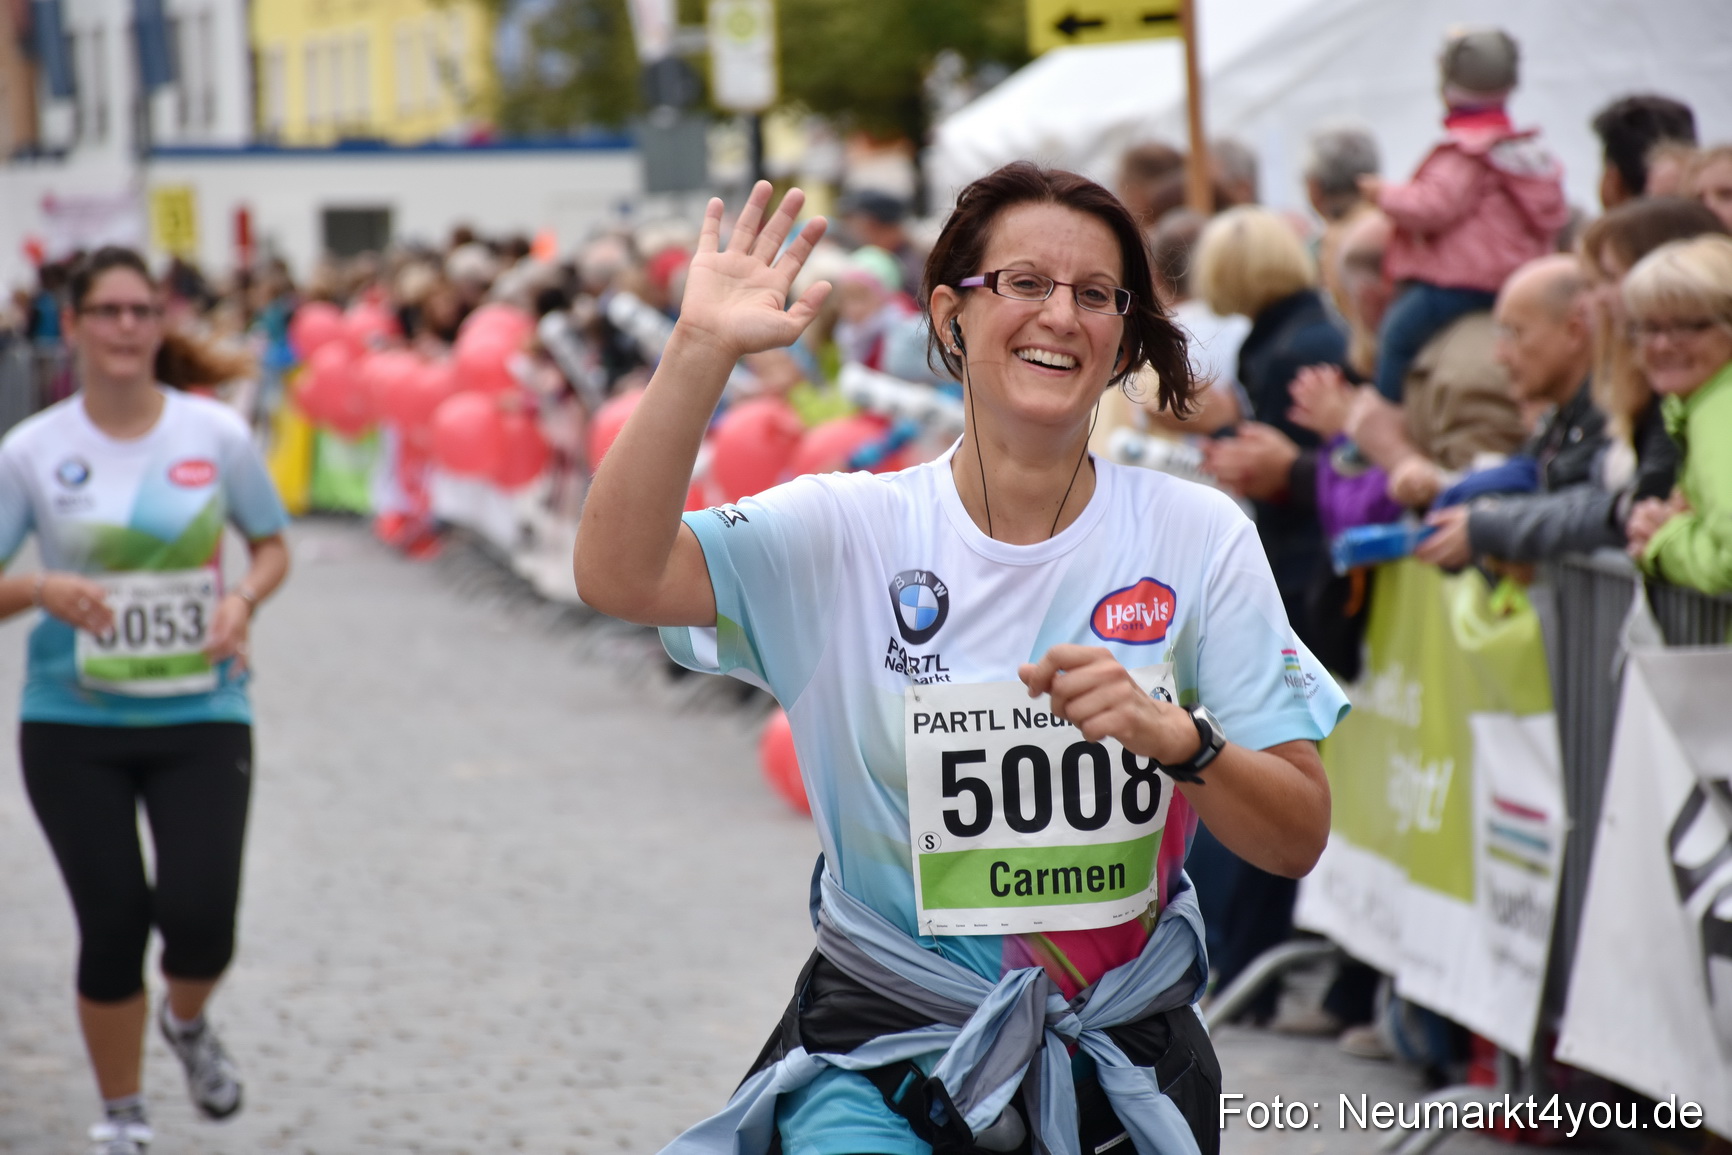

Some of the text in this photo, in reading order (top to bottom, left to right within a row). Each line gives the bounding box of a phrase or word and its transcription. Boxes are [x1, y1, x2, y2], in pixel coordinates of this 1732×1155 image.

[894, 571, 947, 598] BMW
[1106, 597, 1169, 630] Hervis
[913, 710, 1005, 734] PARTL
[941, 740, 1162, 838] 5008
[924, 834, 936, 850] S
[990, 861, 1126, 898] Carmen
